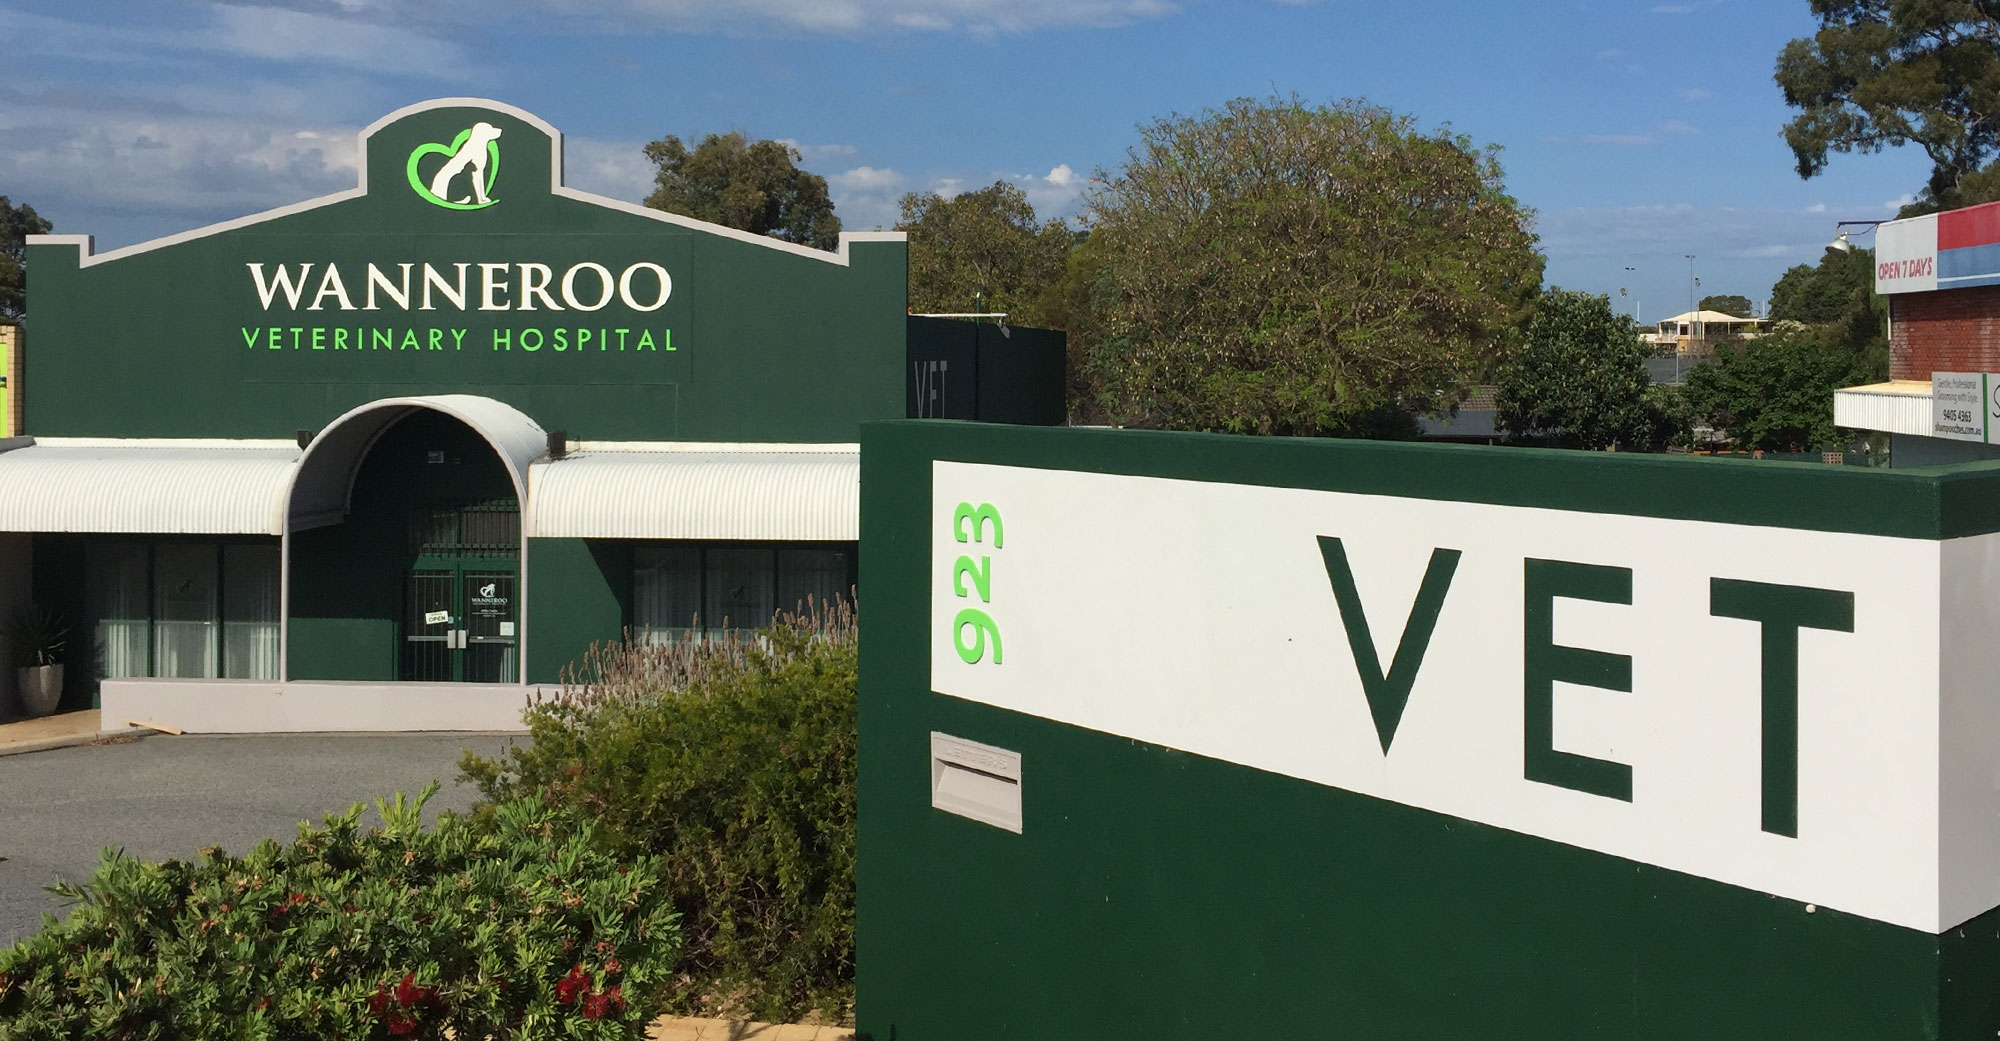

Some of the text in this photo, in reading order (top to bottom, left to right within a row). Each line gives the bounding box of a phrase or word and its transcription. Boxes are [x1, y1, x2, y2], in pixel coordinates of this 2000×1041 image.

[1878, 256, 1933, 281] OPEN 7 DAYS
[246, 262, 672, 312] WANNEROO
[242, 327, 677, 352] VETERINARY HOSPITAL
[1942, 409, 1972, 423] 9405 4363
[953, 501, 1004, 665] 923
[428, 615, 447, 623] OPEN
[1316, 534, 1856, 839] VET
